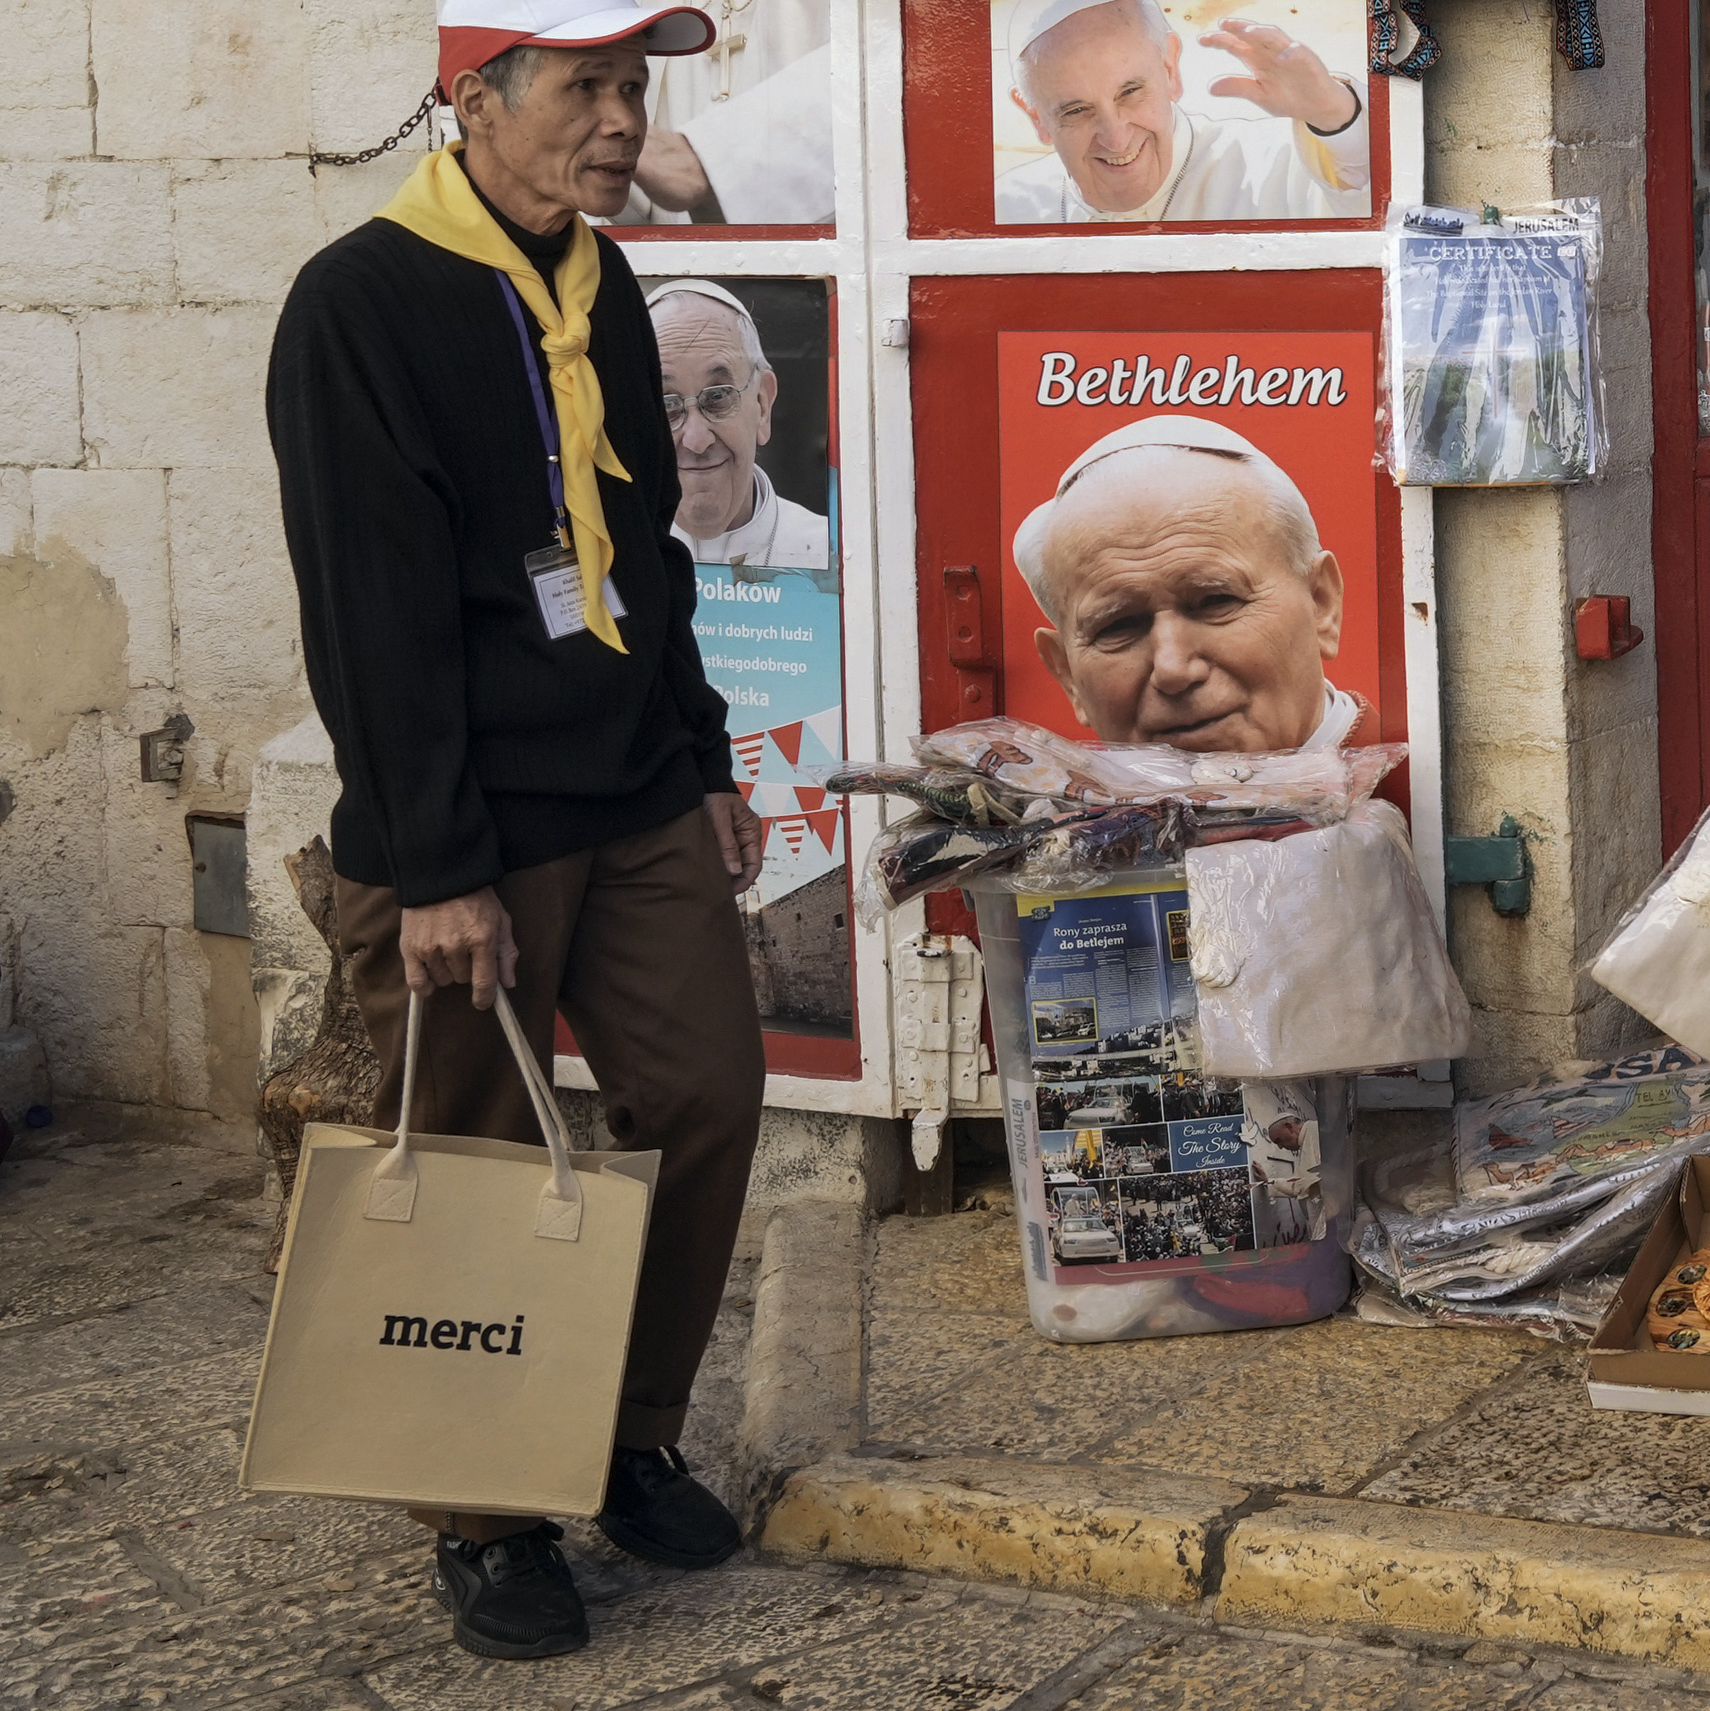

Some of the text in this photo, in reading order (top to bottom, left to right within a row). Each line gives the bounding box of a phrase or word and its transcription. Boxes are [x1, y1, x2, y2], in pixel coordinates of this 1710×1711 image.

[1512, 217, 1580, 234] JERUSALEM
[1428, 245, 1552, 261] CERTIFICATE
[1036, 351, 1347, 406] Bethlehem
[718, 623, 813, 642] i dobrych ludzi
[1053, 923, 1127, 938] Rony zaprasza
[1060, 936, 1125, 950] do Betlejem
[1013, 1098, 1027, 1168] JERUSALEM
[1183, 1122, 1233, 1137] Come Read
[1178, 1137, 1242, 1156] The Story
[1195, 1156, 1226, 1169] Inside
[379, 1314, 526, 1356] merci
